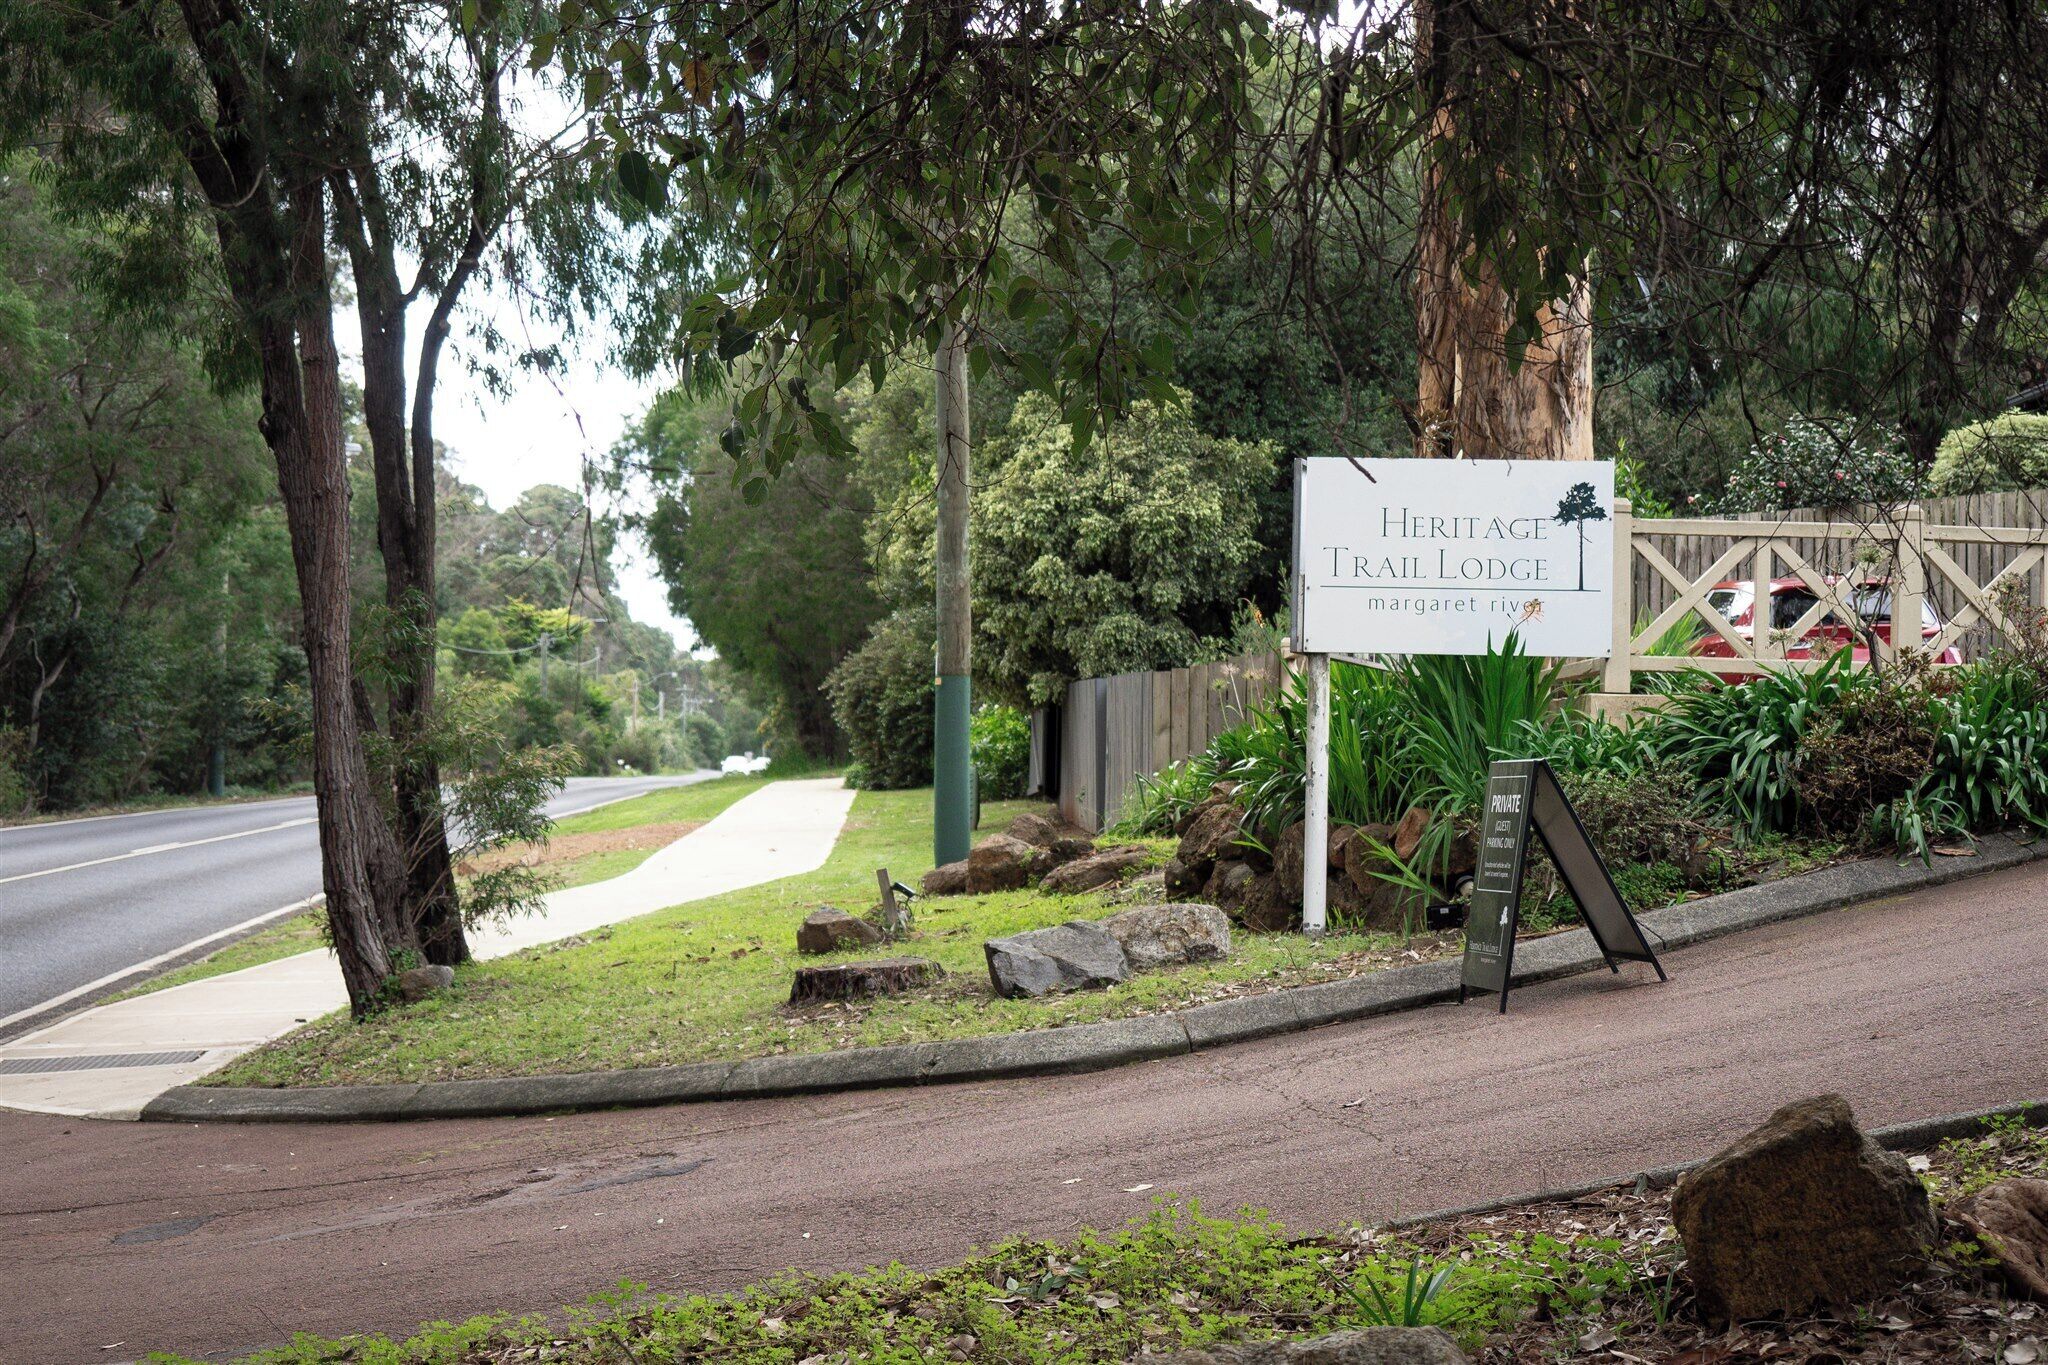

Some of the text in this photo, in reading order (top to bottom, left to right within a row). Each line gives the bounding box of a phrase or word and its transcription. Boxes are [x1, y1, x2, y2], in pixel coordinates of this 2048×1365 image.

[1380, 507, 1547, 540] HERITAGE
[1322, 546, 1548, 581] TRAIL LODGE
[1368, 596, 1477, 616] margaret
[1490, 794, 1522, 813] PRIVATE
